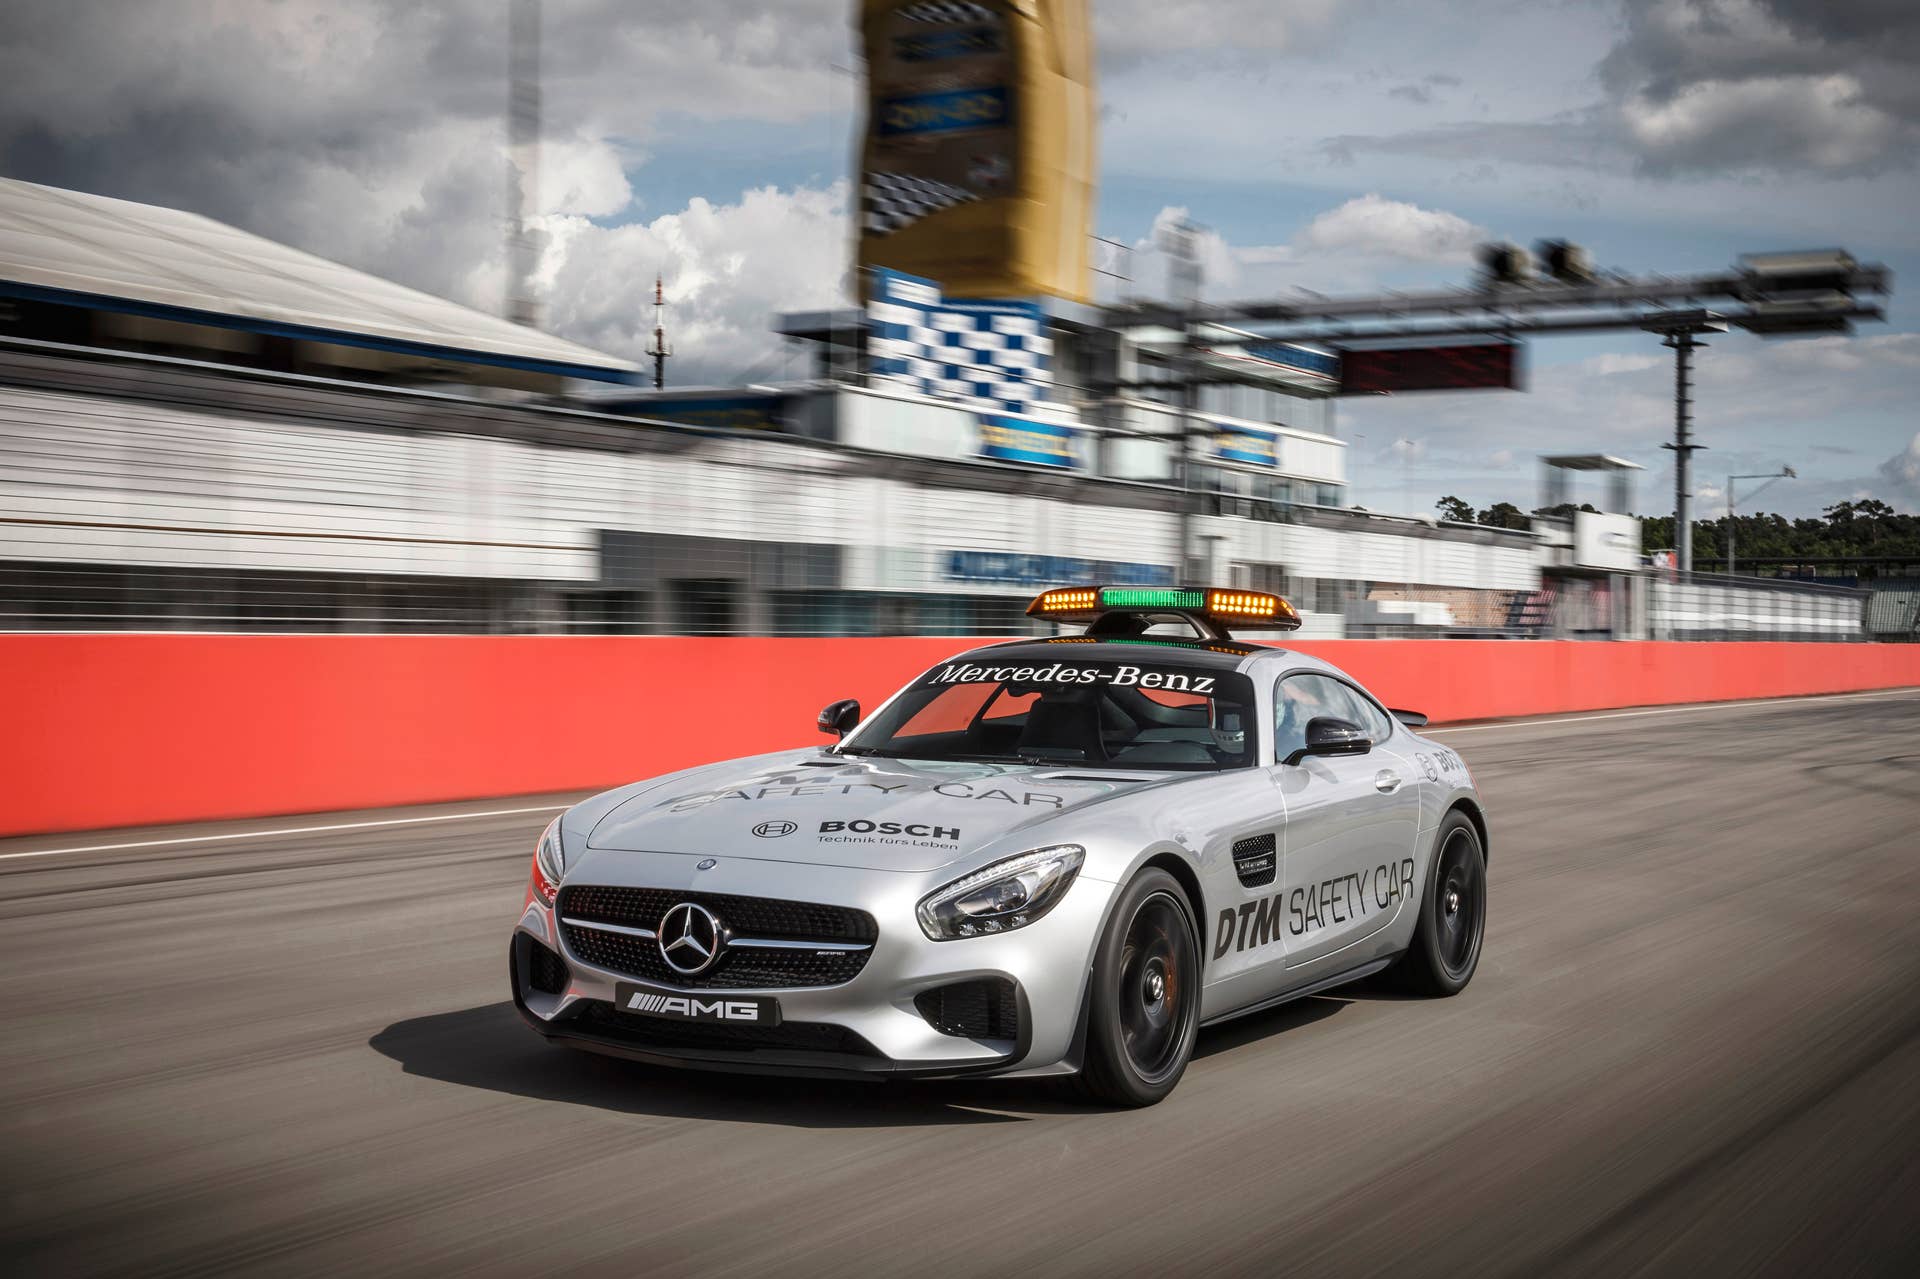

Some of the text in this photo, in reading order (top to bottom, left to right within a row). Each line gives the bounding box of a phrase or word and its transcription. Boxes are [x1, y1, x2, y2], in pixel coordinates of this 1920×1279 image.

[928, 663, 1217, 694] Mercedes-Benz
[668, 782, 1064, 813] SAFETY CAR
[817, 835, 959, 851] Technik fürs Leben
[818, 819, 961, 841] BOSCH
[1213, 857, 1415, 961] DTM SAFETY CAR
[659, 996, 758, 1021] AMG
